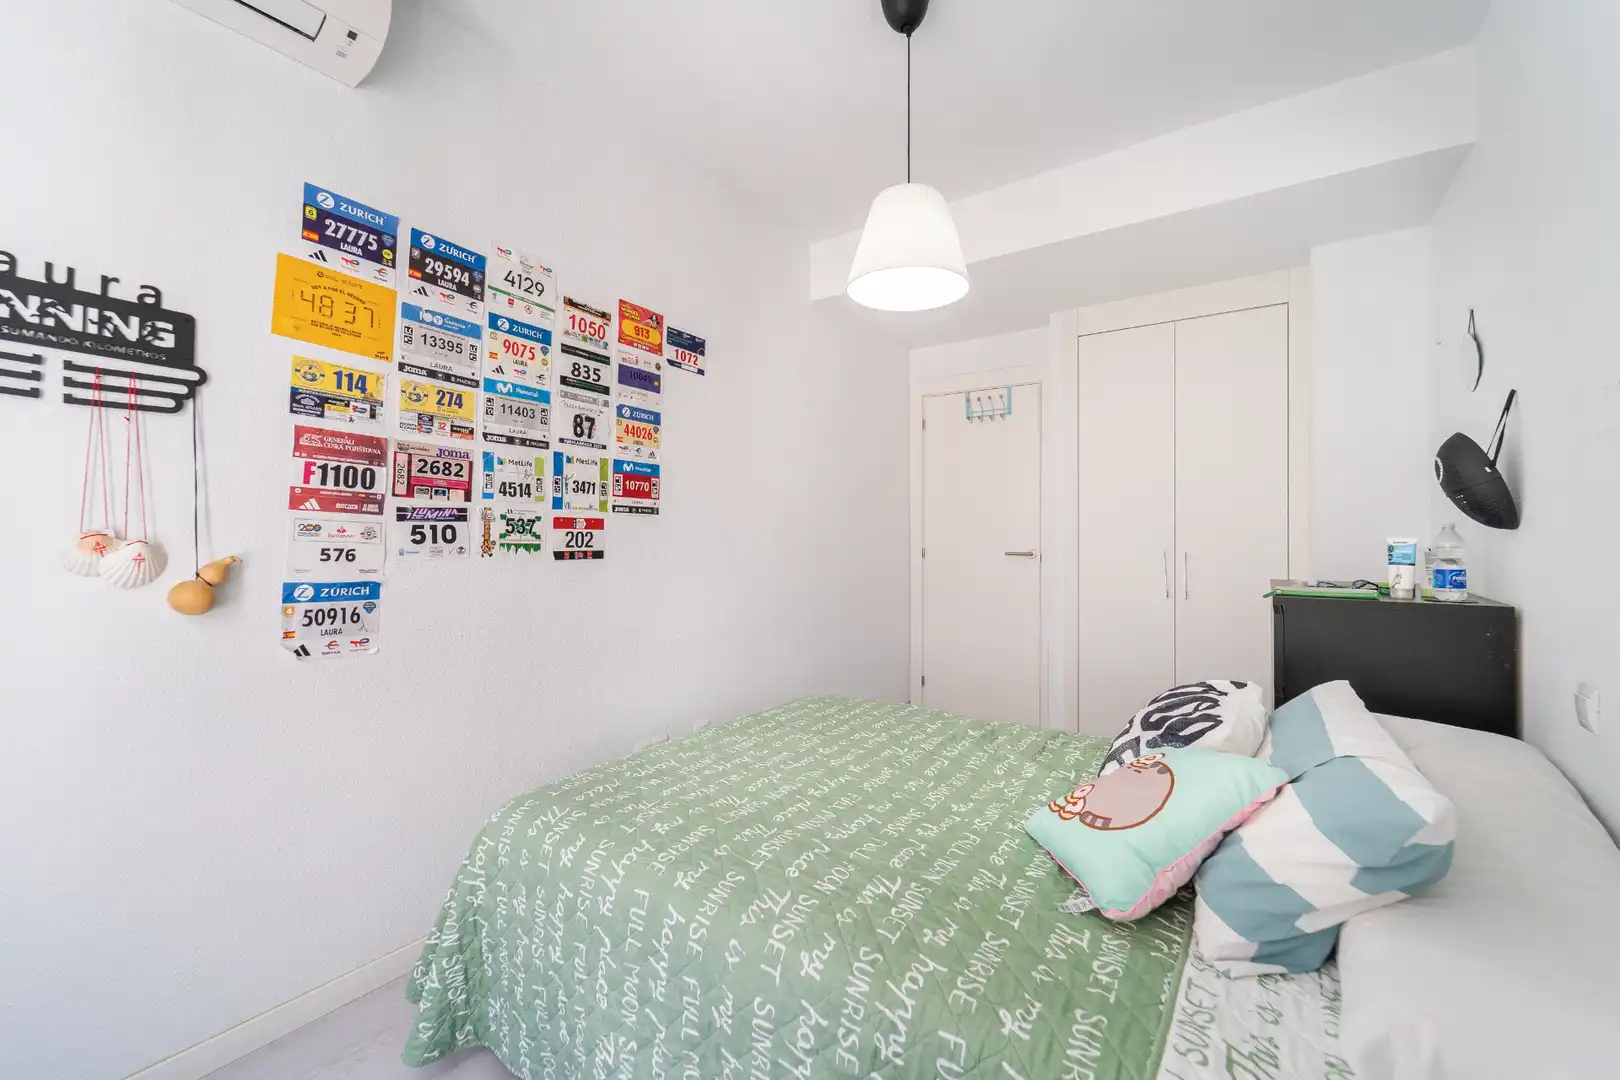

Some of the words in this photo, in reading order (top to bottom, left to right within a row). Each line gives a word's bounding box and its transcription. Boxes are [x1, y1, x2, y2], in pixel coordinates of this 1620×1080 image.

[340, 202, 385, 225] ZURICH
[325, 219, 378, 251] 27775
[340, 242, 363, 256] LAURA
[439, 243, 476, 264] ZURICH
[425, 257, 470, 286] 29594
[503, 270, 545, 297] 4129
[438, 278, 458, 291] LAURA
[512, 324, 543, 340] ZURICH
[568, 314, 606, 340] 1050
[1, 325, 79, 345] SUMANDO
[82, 340, 167, 360] KILOMETROS
[421, 333, 463, 355] 13395
[503, 338, 536, 361] 9075
[429, 362, 453, 372] LAURA
[674, 348, 699, 366] 1072
[333, 369, 367, 394] 114
[571, 361, 602, 383] 835
[436, 389, 464, 409] 274
[500, 403, 536, 419] 11403
[573, 413, 596, 440] 87
[632, 410, 654, 421] ZURICH
[323, 436, 355, 445] GENERALI
[623, 423, 653, 441] 44026
[397, 463, 406, 485] 2682
[416, 458, 464, 478] 2682
[508, 458, 533, 468] MetLife
[575, 457, 598, 467] MetLife
[303, 461, 376, 490] F1100
[572, 480, 596, 495] 3471
[625, 480, 649, 492] 10770
[498, 481, 532, 498] 4514
[410, 524, 457, 545] 510
[505, 517, 537, 534] 537
[565, 531, 594, 548] 202
[319, 548, 356, 562] 576
[320, 586, 370, 597] ZURICH
[302, 606, 361, 627] 50916
[320, 628, 343, 636] LAURA
[528, 806, 569, 837] This
[538, 810, 587, 877] SUNSET
[647, 825, 715, 876] SUNRISE
[746, 829, 801, 870] SUNSET
[576, 839, 615, 929] SUNRISE
[856, 874, 901, 905] This
[686, 871, 745, 962] SUNRISE
[739, 888, 792, 926] This
[876, 882, 932, 944] SUNSET
[996, 878, 1039, 931] SUNSET
[531, 885, 548, 974] SUNRISE
[625, 889, 649, 952] FULL
[922, 917, 959, 946] my
[760, 894, 819, 988] SUNSET
[1044, 923, 1091, 960] This
[800, 932, 837, 981] my
[1086, 934, 1131, 1004] SUNSET
[948, 931, 1010, 1014] SUNRISE
[621, 963, 642, 1030] MOON
[837, 946, 883, 1075] SUNRISE
[873, 953, 948, 1066] happy
[999, 992, 1043, 1041] my
